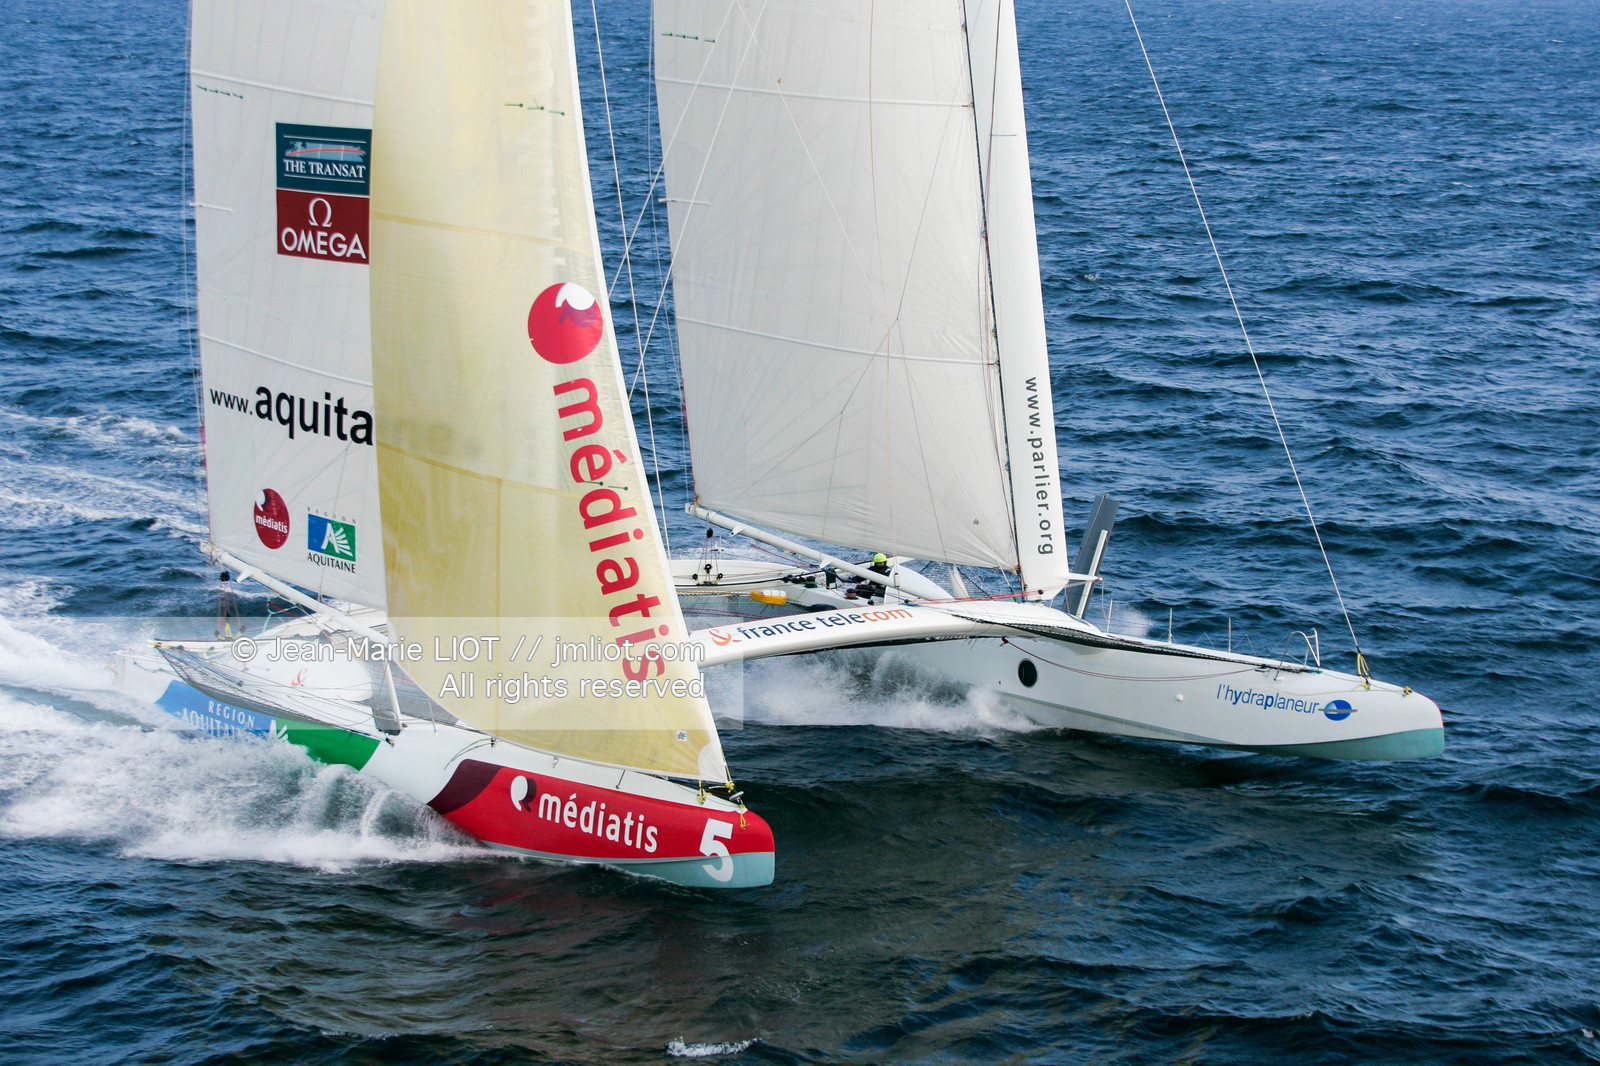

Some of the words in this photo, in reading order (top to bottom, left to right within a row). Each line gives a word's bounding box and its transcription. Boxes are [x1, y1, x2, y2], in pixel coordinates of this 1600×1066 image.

[283, 159, 306, 173] THE
[308, 161, 366, 178] TRANSAT
[281, 227, 367, 259] OMEGA
[210, 386, 374, 446] www.aquita
[1025, 376, 1054, 556] www.parlier.org
[255, 513, 289, 534] médiatis
[553, 377, 671, 685] médiatis
[307, 552, 356, 574] AQUITAINE
[737, 619, 817, 640] france
[817, 607, 913, 628] telecom
[208, 700, 255, 728] REGION
[1216, 683, 1319, 715] l'hydraplaneur
[538, 792, 659, 853] médiatis
[699, 818, 734, 883] 5
